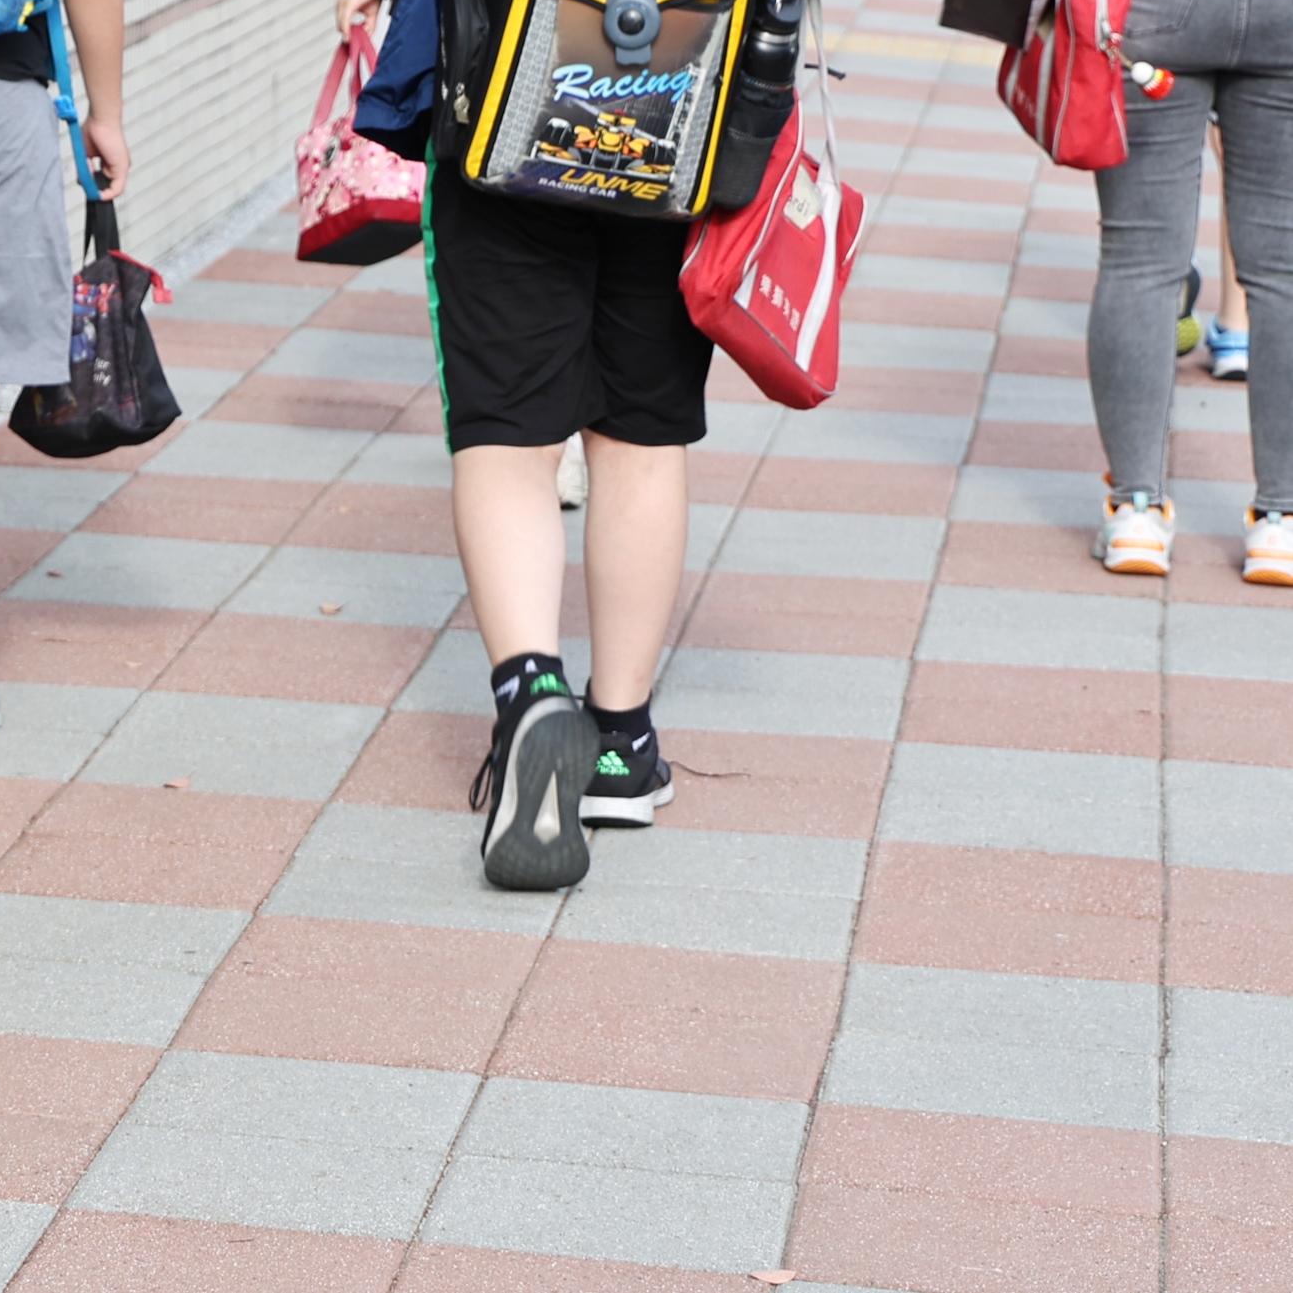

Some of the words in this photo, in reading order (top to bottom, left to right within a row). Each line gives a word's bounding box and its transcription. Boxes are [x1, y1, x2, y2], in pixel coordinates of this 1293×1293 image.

[552, 63, 695, 103] Racing
[538, 177, 588, 194] RACING
[589, 186, 617, 199] CAR
[559, 168, 669, 201] UNME
